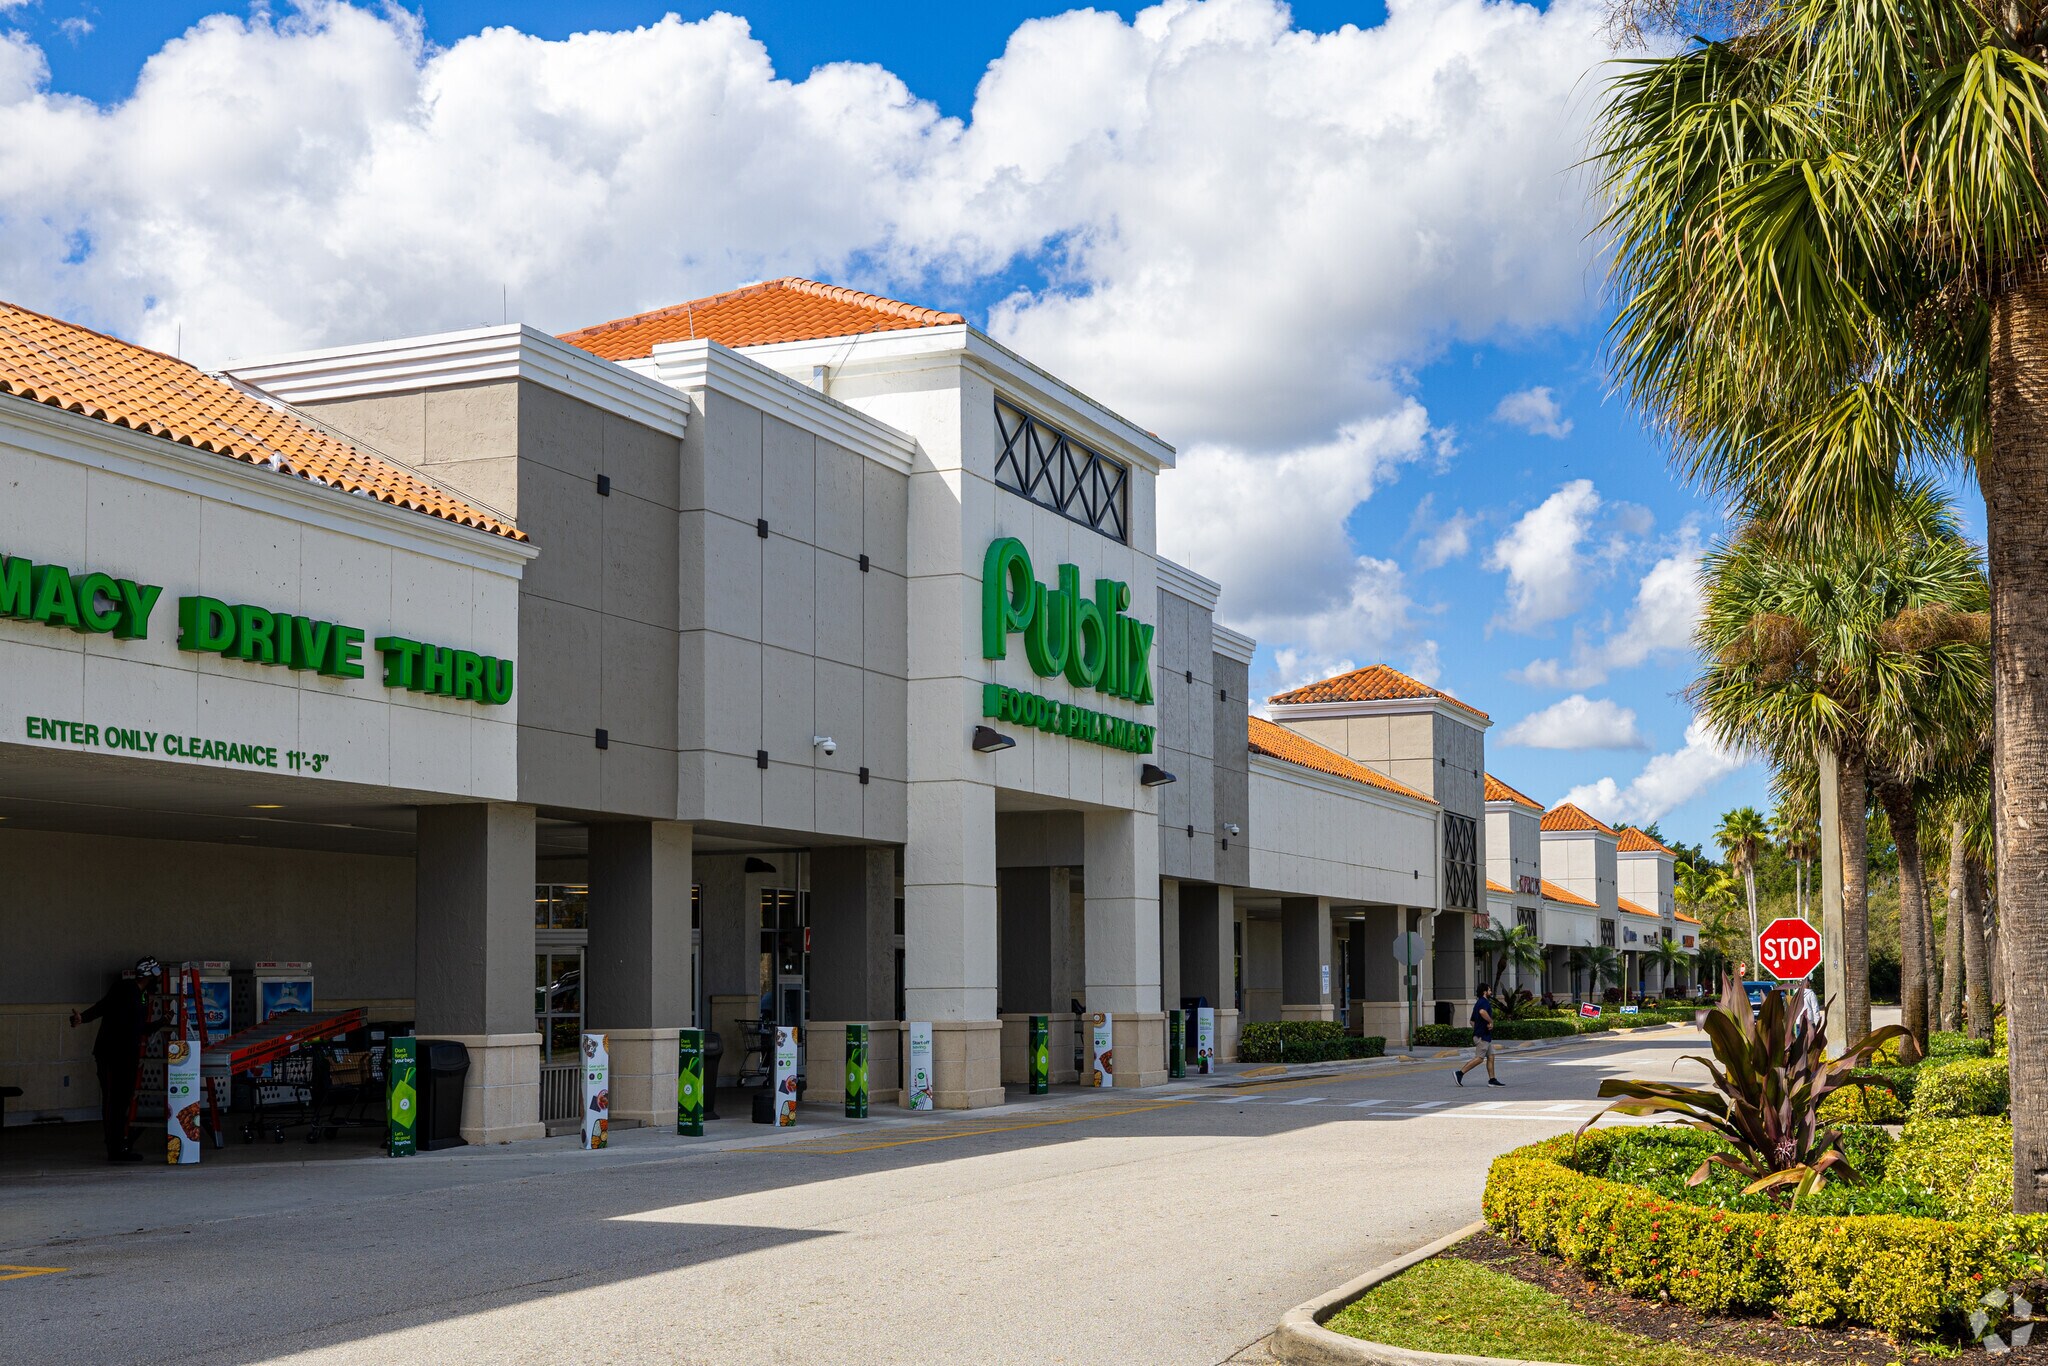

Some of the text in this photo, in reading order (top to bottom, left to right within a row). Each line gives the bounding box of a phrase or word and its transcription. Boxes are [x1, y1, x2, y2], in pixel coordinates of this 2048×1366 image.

[178, 595, 365, 680] DRIVE
[375, 636, 514, 706] THRU
[982, 537, 1155, 705] Publix
[26, 716, 99, 746] ENTER
[104, 726, 158, 753] ONLY
[163, 734, 278, 768] CLEARANCE
[983, 684, 1049, 727] FOOD
[1063, 704, 1156, 754] PHARMACY
[1763, 937, 1817, 961] STOP
